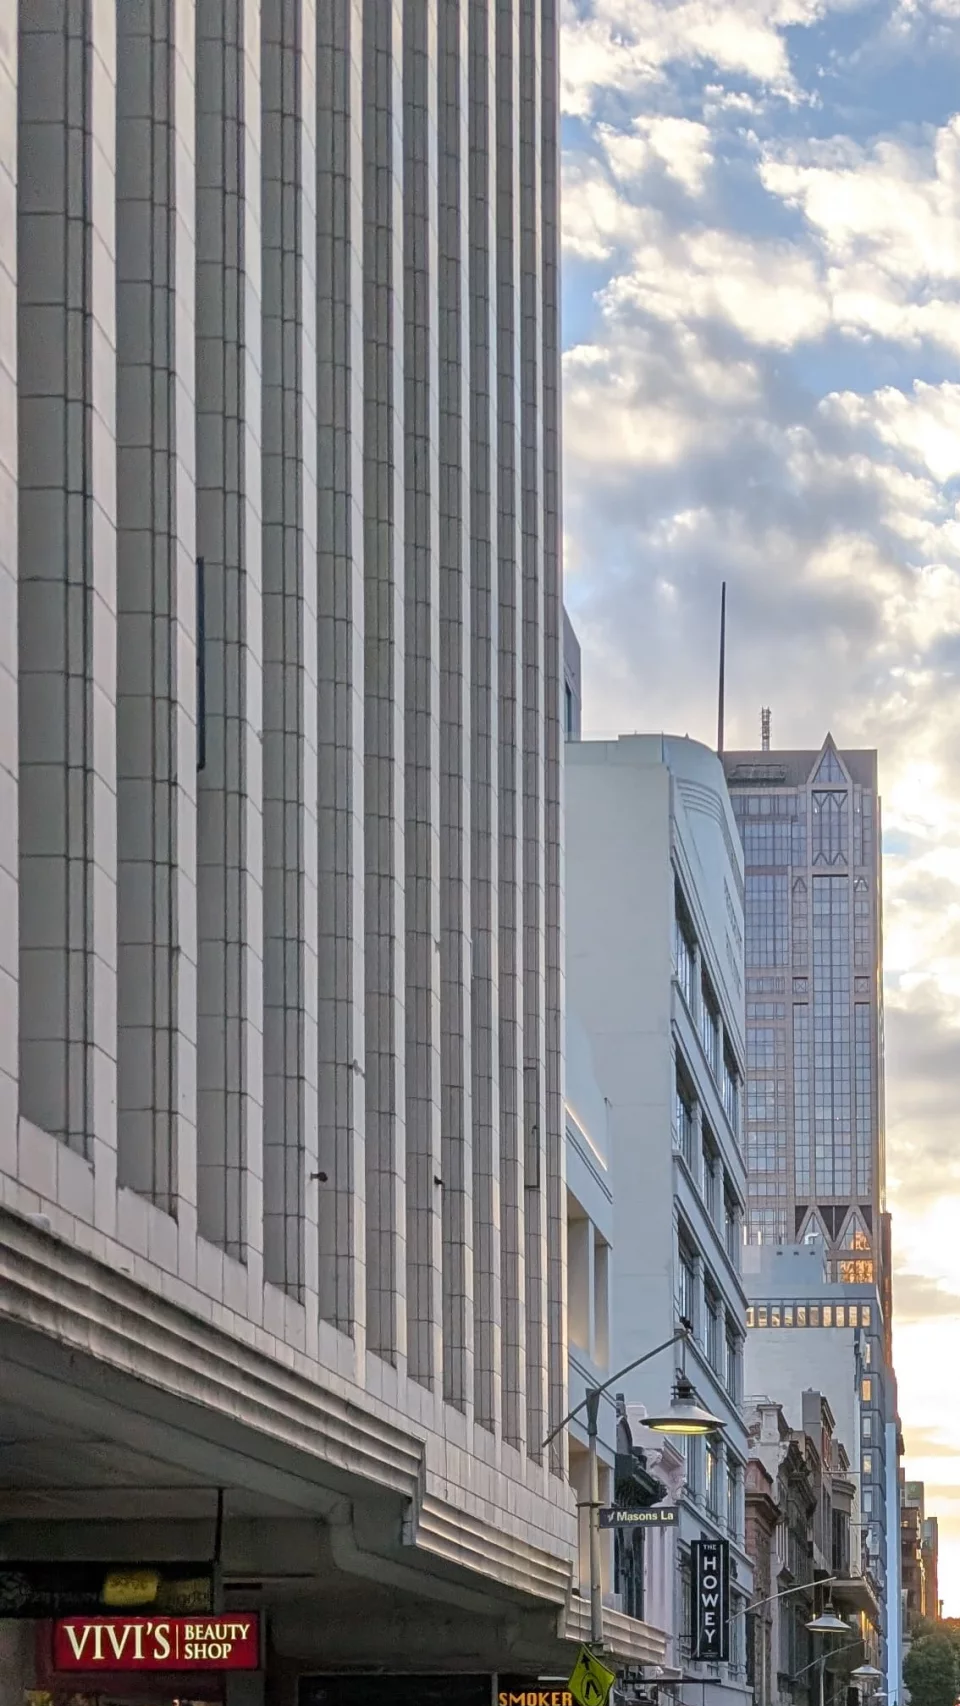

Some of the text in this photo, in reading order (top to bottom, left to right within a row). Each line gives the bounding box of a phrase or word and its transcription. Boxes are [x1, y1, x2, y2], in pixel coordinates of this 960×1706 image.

[616, 1510, 674, 1522] Masons La
[703, 1543, 717, 1551] THE
[701, 1556, 719, 1644] HOWEY
[63, 1622, 171, 1660] VIVI'S
[184, 1624, 250, 1641] BEAUTY
[184, 1643, 232, 1660] SHOP
